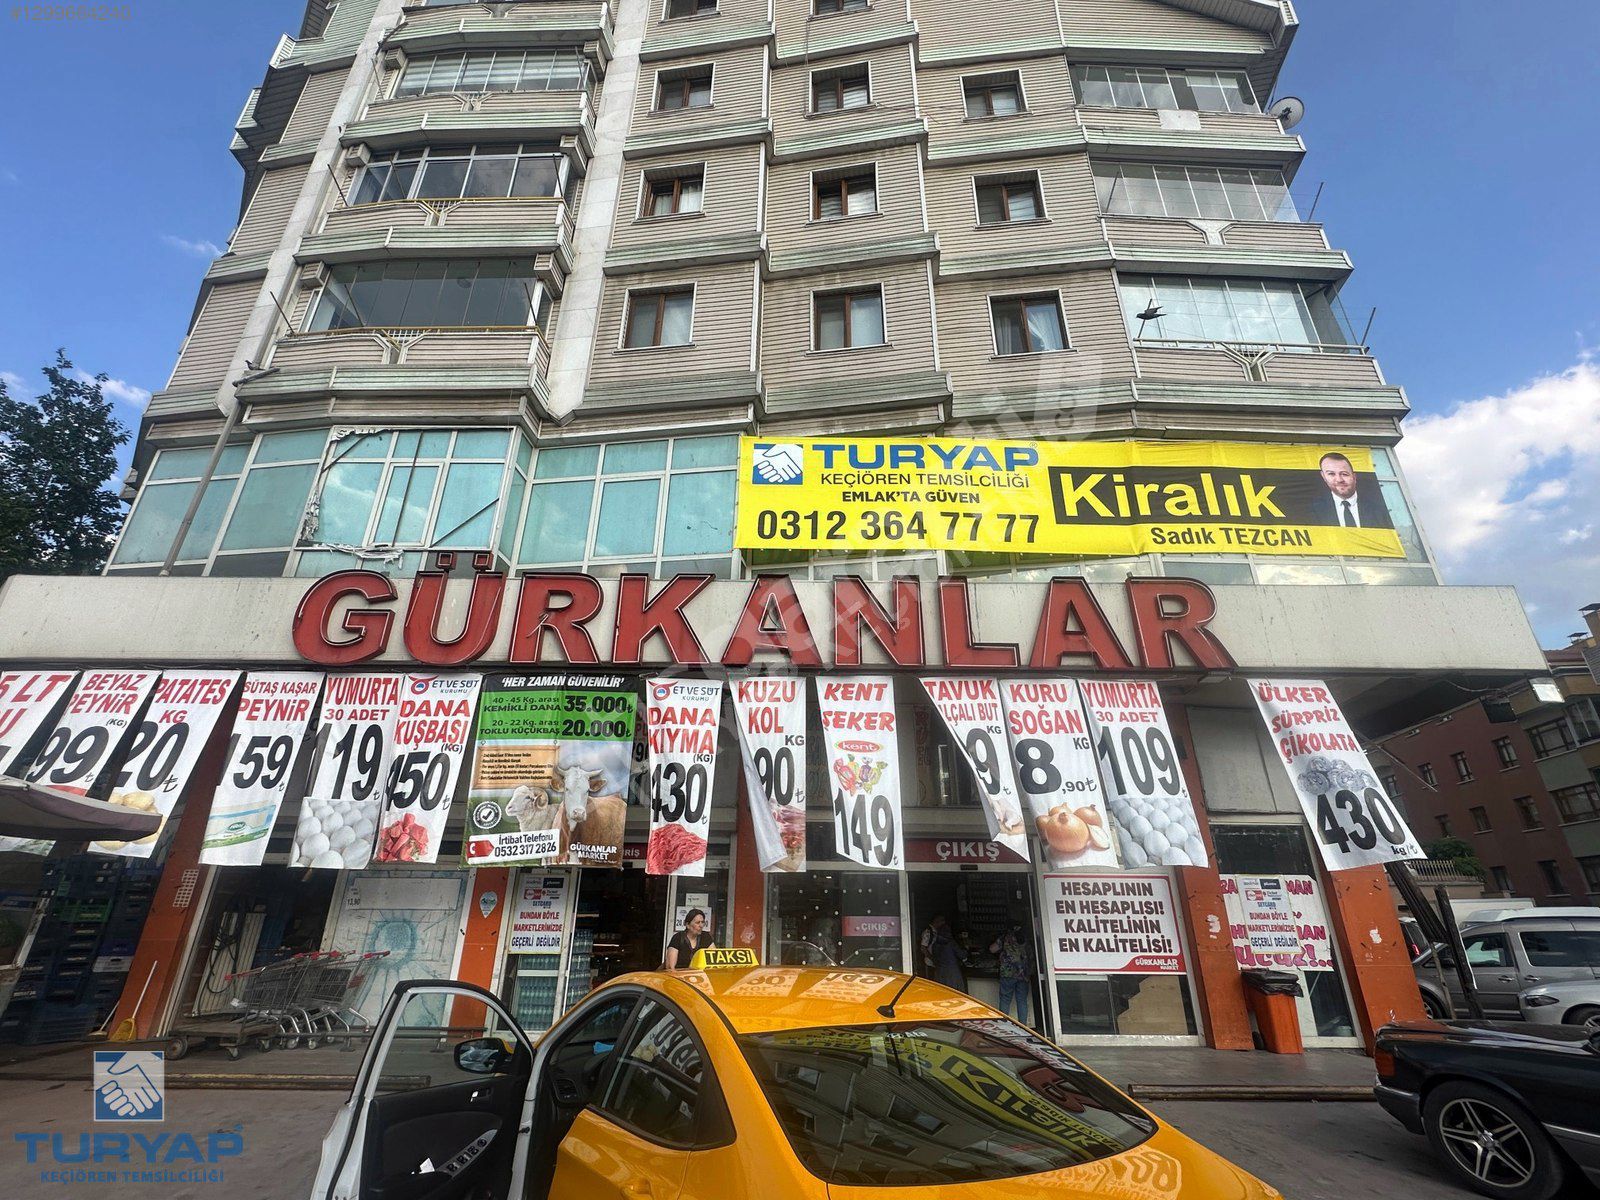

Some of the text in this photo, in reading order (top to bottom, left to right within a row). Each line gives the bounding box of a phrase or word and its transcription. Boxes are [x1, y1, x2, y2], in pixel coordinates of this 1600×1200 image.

[812, 443, 1038, 472] TURYAP
[821, 471, 1029, 489] KEÇİÖREN TEMSİLCİLİĞİ
[842, 489, 980, 504] EMLAK'TA GÜVEN
[1060, 473, 1286, 518] Kiralık
[757, 509, 1039, 544] 0312 364 77 77
[1150, 527, 1313, 548] Sadık TEZCAN
[291, 550, 1236, 670] GÜRKANLAR
[10, 674, 72, 702] LT
[82, 673, 148, 691] BEYAZ
[280, 681, 318, 698] KAŞAR
[432, 679, 446, 689] ET
[446, 679, 460, 689] VE
[529, 675, 567, 688] ZAMAN
[672, 685, 685, 695] ET
[686, 685, 699, 696] VE
[922, 679, 997, 701] TAVUK
[154, 678, 232, 705] PATATES
[325, 677, 399, 706] YUMURTA
[738, 680, 796, 703] KUZU
[823, 682, 888, 702] KENT
[1009, 683, 1069, 703] KURU
[1080, 682, 1162, 708] YUMURTA
[1258, 682, 1332, 704] ÜLKER
[159, 709, 188, 724] KG
[238, 698, 311, 722] PEYNİR
[324, 709, 391, 721] 30 ADET
[399, 699, 470, 718] DANA
[483, 703, 561, 712] KEMİKLİ DANA
[648, 706, 717, 727] DANA
[977, 702, 999, 721] BUT
[1096, 710, 1158, 723] 30 ADET
[748, 706, 784, 735] KOL
[821, 710, 895, 733] ŞEKER
[1008, 703, 1084, 735] SOĞAN
[1271, 705, 1341, 734] SÜRPRİZ
[986, 725, 1002, 734] KG
[441, 743, 463, 754] (KG)
[648, 727, 715, 755] KIYMA
[784, 734, 805, 746] KG
[1073, 737, 1090, 750] KG
[1279, 730, 1360, 765] ÇİKOLATA
[693, 753, 714, 764] (KG)
[1015, 738, 1062, 795] 8
[1097, 725, 1181, 796] 109
[833, 787, 895, 867] 149
[1316, 787, 1406, 854] 430
[494, 842, 557, 858] 0532 317 2826
[570, 841, 618, 854] GÜRKANLAR
[577, 852, 609, 861] MARKET
[936, 841, 1000, 861] ÇIKIŞ
[1060, 881, 1154, 897] HESAPLININ
[520, 909, 560, 920] BUNDAN BÖYLE
[1055, 900, 1165, 915] EN HESAPLISI!
[1249, 909, 1288, 921] BUNDAN BÖYLE
[513, 921, 563, 932] MARKETLERİMİZDE
[1063, 914, 1162, 934] KALİTELİNİN
[1248, 922, 1296, 933] MARKETLERİMİZDE
[511, 934, 534, 949] GEÇERLİ
[1058, 933, 1173, 954] EN KALİTELİSİ!
[1250, 935, 1273, 949] GEÇERLİ
[705, 950, 751, 964] TAKSİ
[1135, 957, 1178, 967] GÜRKANLAR
